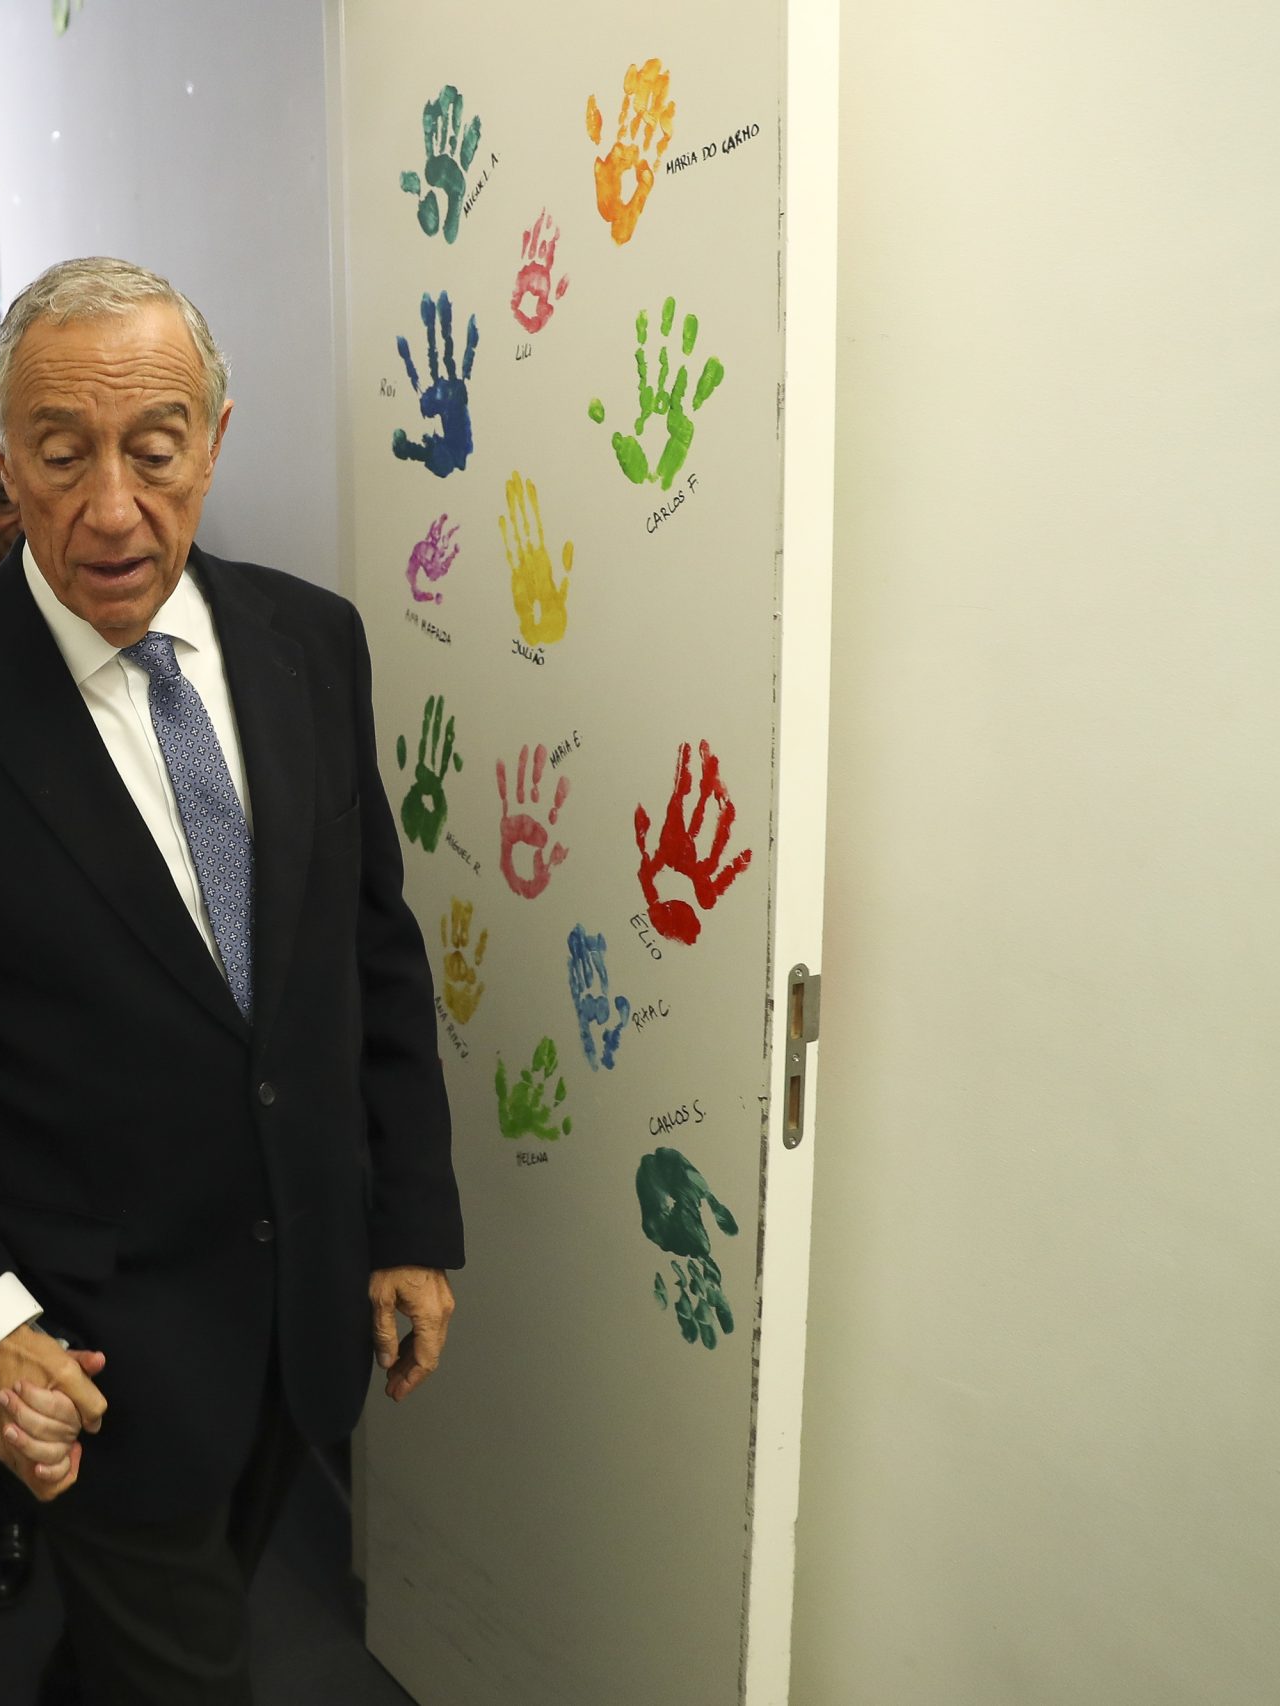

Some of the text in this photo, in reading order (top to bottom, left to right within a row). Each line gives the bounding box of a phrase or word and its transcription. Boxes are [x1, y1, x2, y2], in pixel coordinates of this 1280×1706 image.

[702, 142, 717, 161] DO
[722, 123, 760, 154] CARMO
[646, 490, 685, 534] CARLOS
[649, 1104, 690, 1136] CARLOS
[516, 1150, 549, 1167] HELENA
